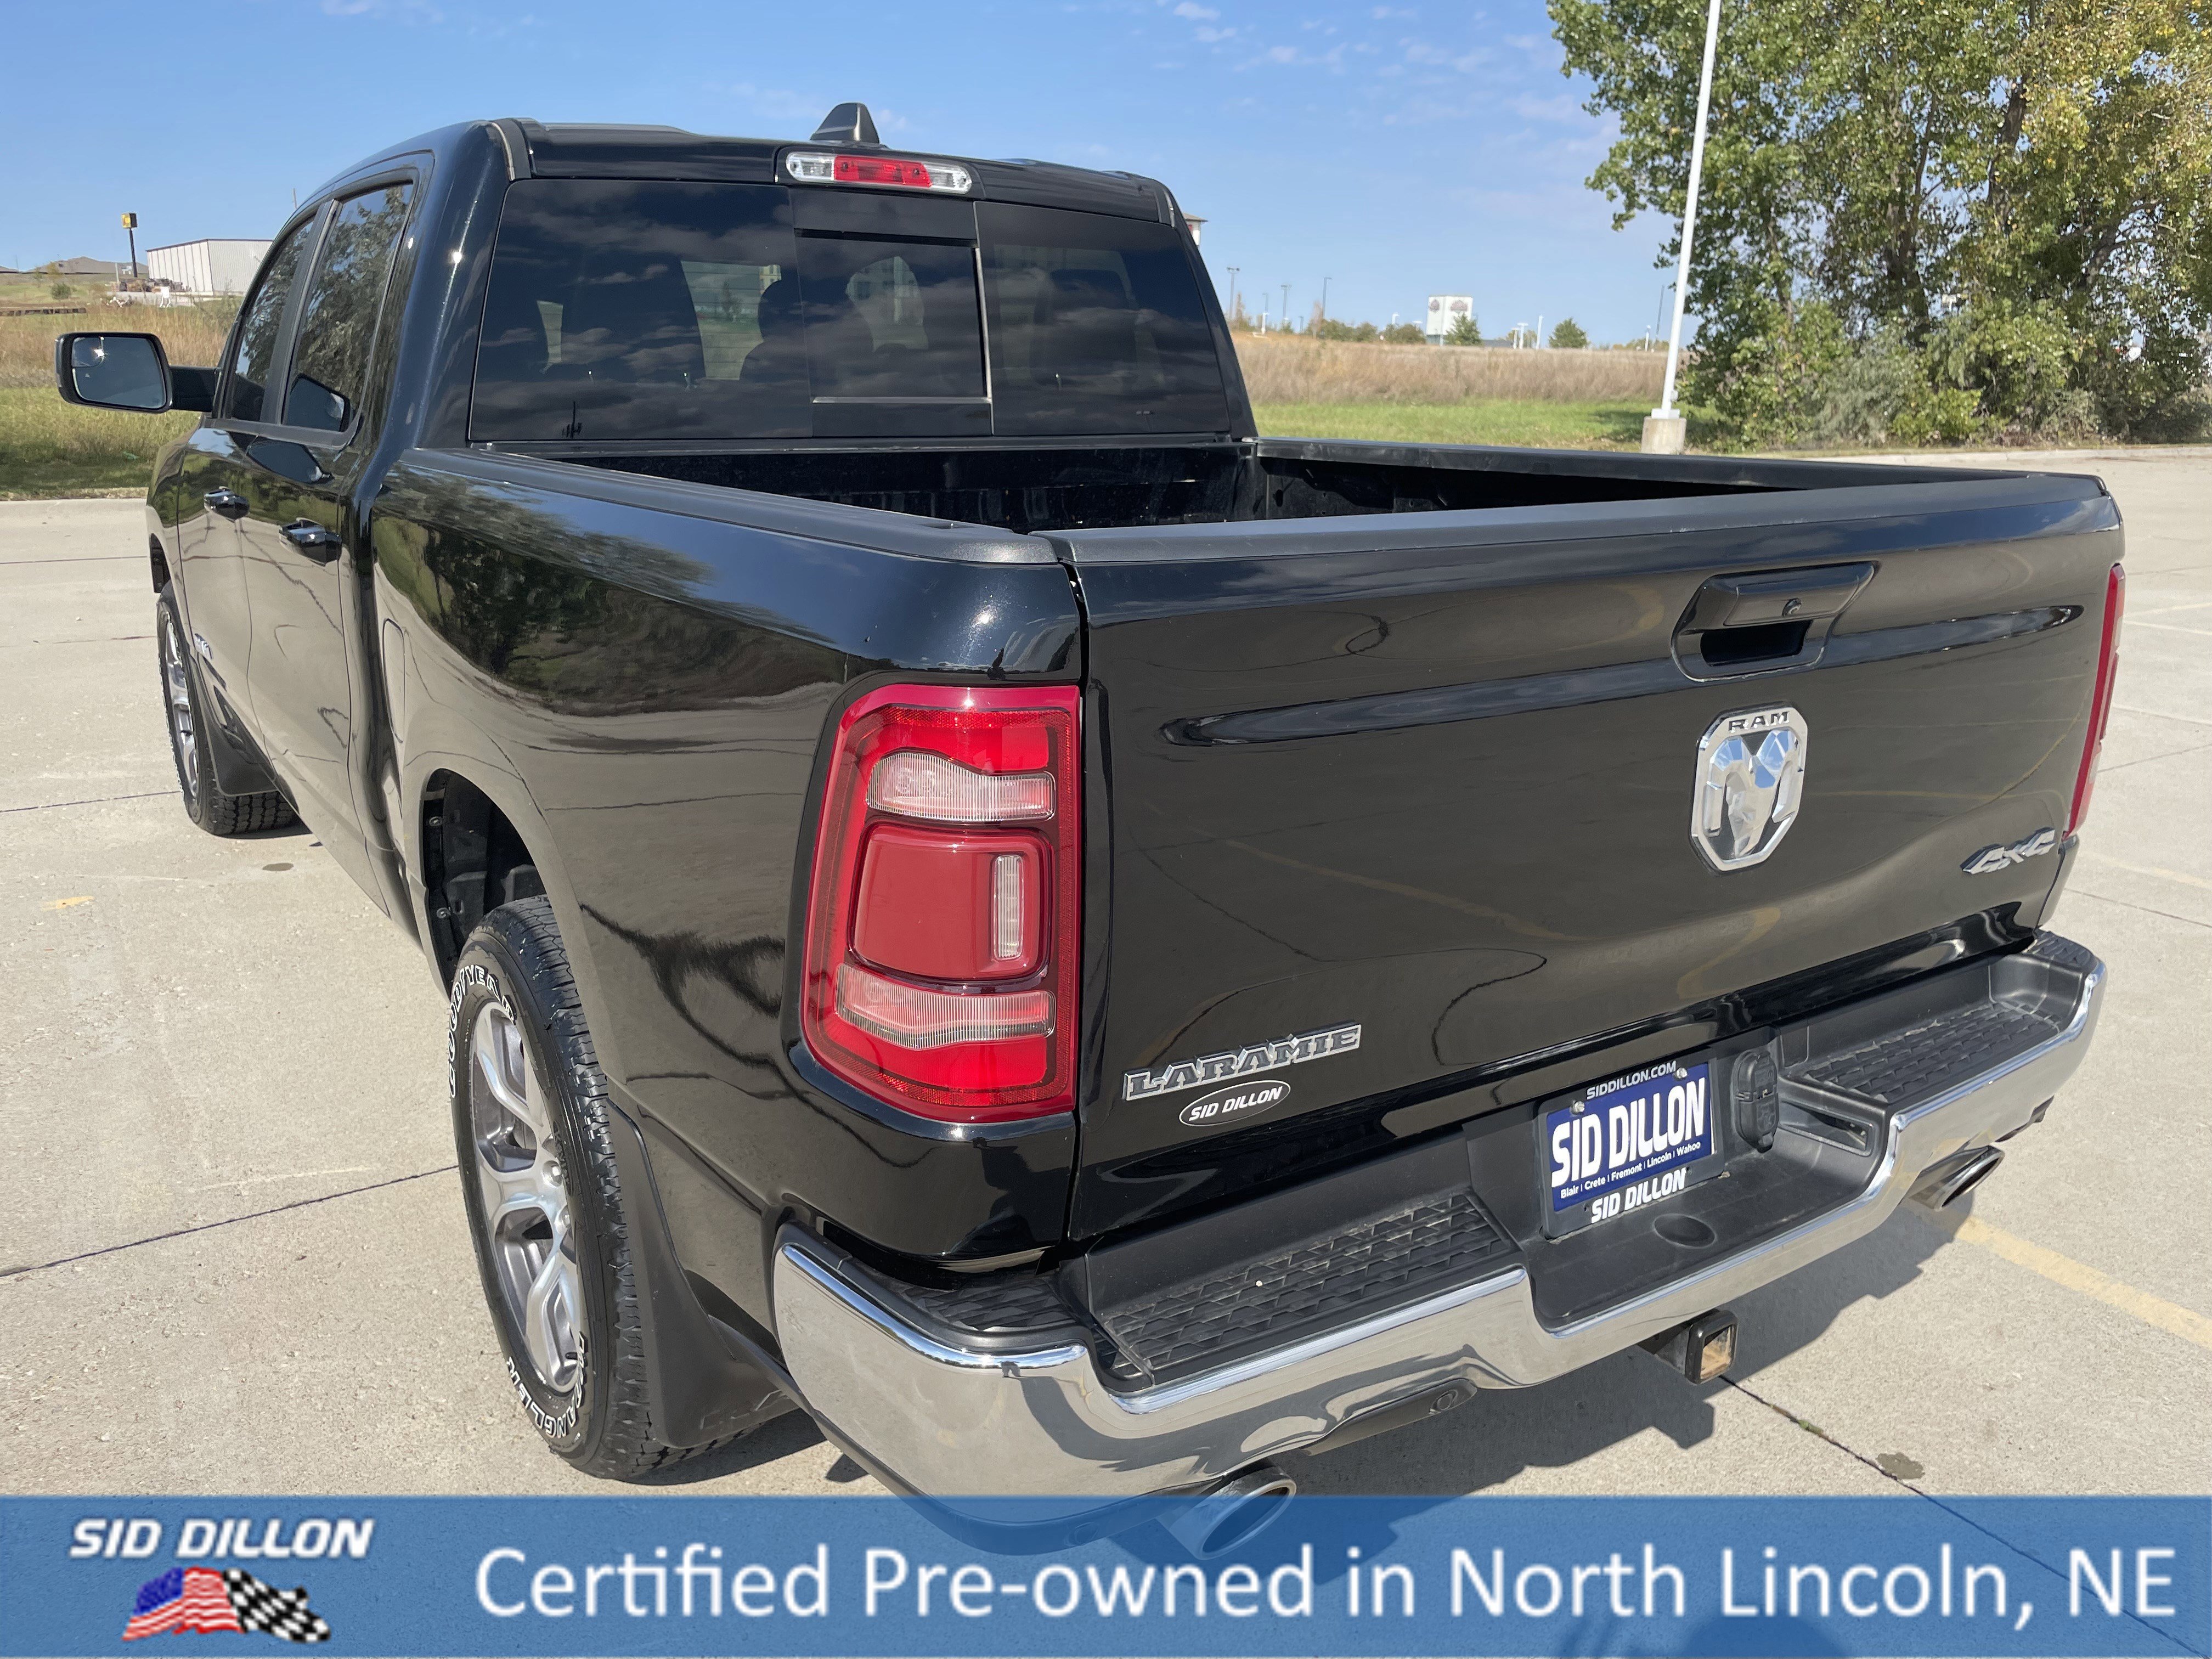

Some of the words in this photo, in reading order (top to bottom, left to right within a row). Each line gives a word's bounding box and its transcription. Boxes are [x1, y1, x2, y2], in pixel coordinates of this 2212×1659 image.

[1728, 711, 1791, 733] RAM
[448, 964, 517, 1098] GOODYEAR
[1123, 1023, 1362, 1101] LARAMIE
[1585, 1060, 1677, 1100] SIDDILLON.COM
[1189, 1102, 1218, 1121] SID
[1222, 1086, 1283, 1114] DILLON
[1551, 1113, 1602, 1188] SID
[1609, 1077, 1706, 1169] DILLON
[1560, 1185, 1579, 1199] Blair
[1584, 1177, 1606, 1191] Crete
[1611, 1162, 1643, 1181] Fremont
[1646, 1151, 1672, 1169] Lincoln
[1676, 1141, 1701, 1157] Wahoo
[1591, 1192, 1621, 1224] SID
[1624, 1166, 1687, 1211] DILLON
